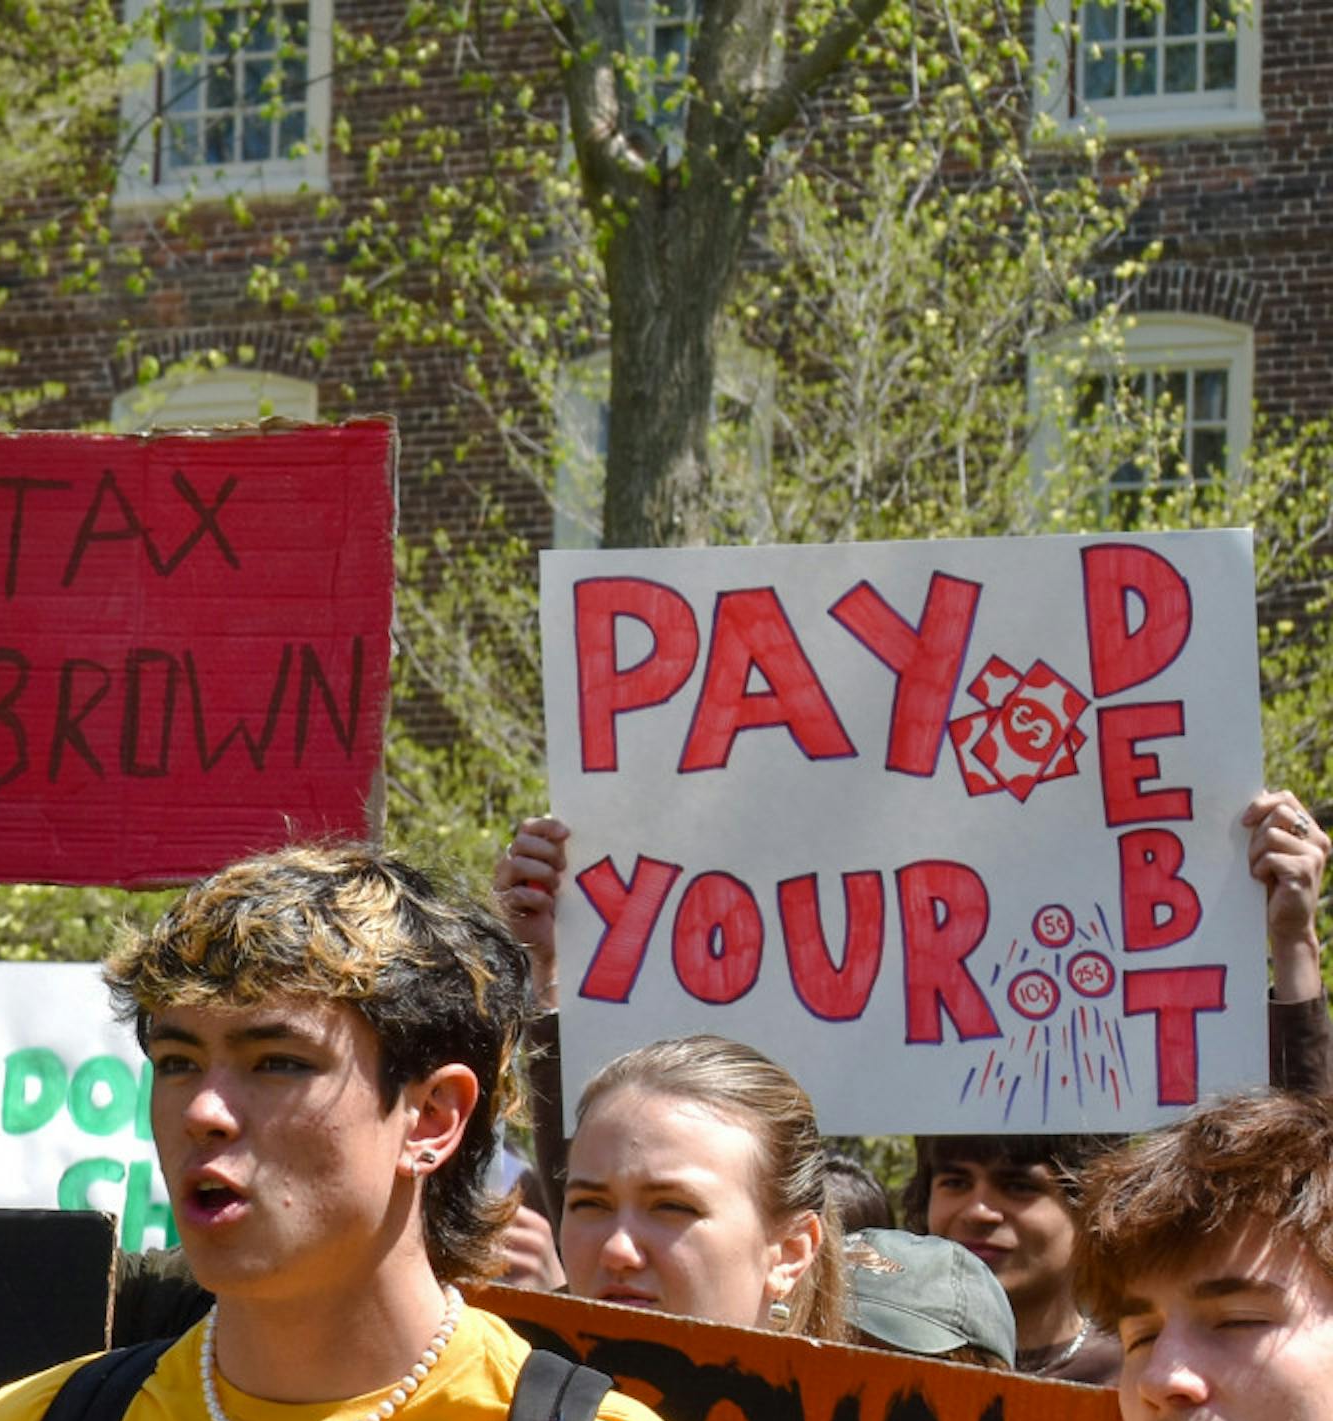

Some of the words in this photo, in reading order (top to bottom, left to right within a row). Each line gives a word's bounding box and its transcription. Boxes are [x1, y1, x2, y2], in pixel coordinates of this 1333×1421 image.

[572, 570, 983, 777] PAY
[1080, 542, 1227, 1106] DEBT
[575, 854, 1003, 1045] YOUR
[1043, 914, 1067, 936] 5¢
[1075, 962, 1105, 985] 25¢
[1019, 981, 1049, 1003] 10¢
